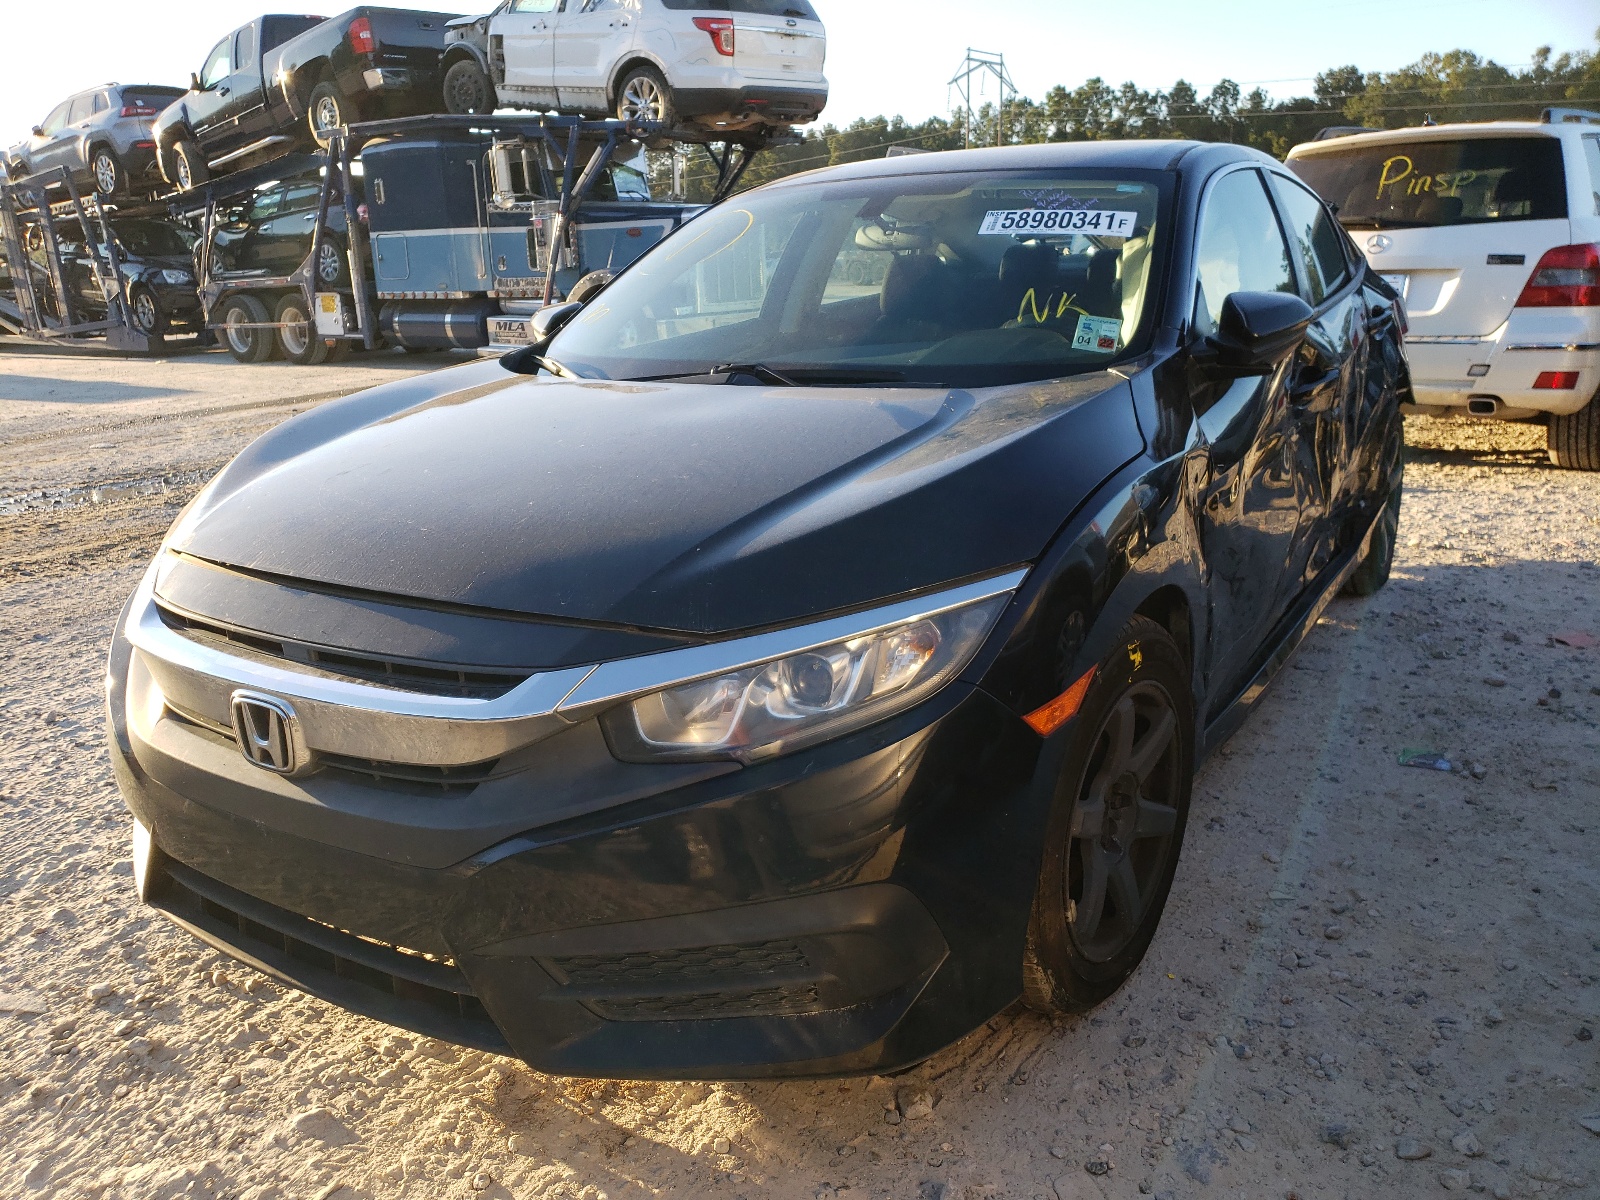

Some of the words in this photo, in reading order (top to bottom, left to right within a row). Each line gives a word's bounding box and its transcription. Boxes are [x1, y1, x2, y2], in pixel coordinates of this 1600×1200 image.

[1001, 211, 1116, 230] 58980341
[1118, 219, 1129, 229] F
[495, 321, 526, 332] MLA
[1077, 335, 1092, 345] 04
[1099, 337, 1115, 349] 22
